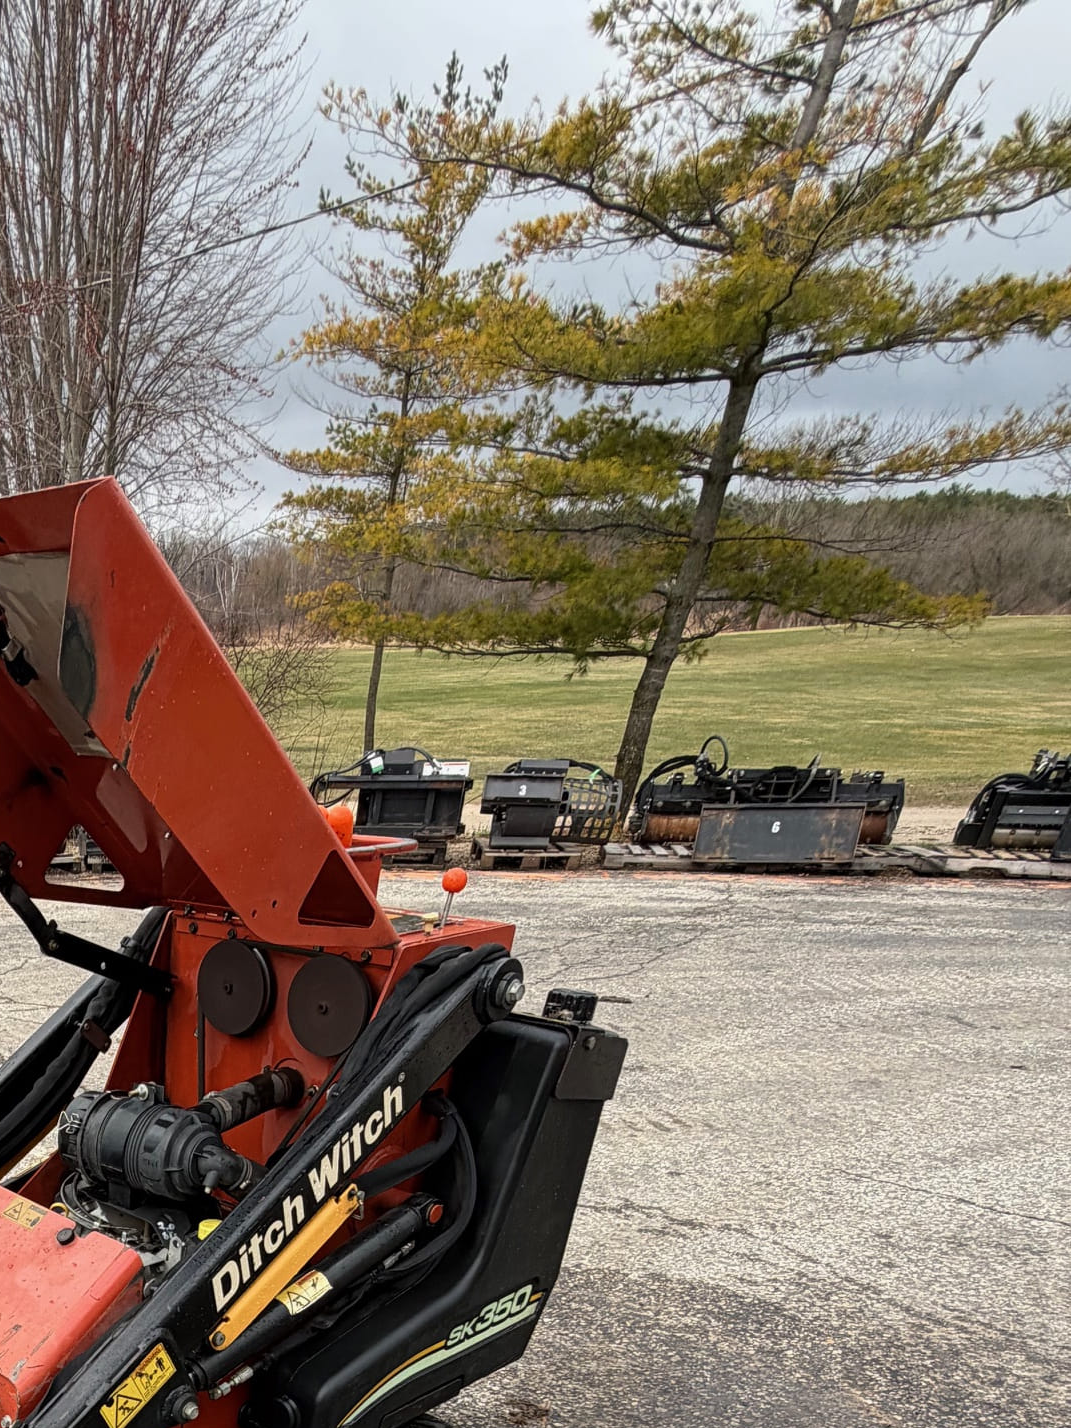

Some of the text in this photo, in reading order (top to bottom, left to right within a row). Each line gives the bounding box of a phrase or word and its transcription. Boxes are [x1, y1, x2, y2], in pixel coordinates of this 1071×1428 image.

[518, 785, 527, 796] 3
[771, 821, 781, 833] 6
[211, 1194, 305, 1313] Ditch
[447, 1284, 533, 1347] SK350
